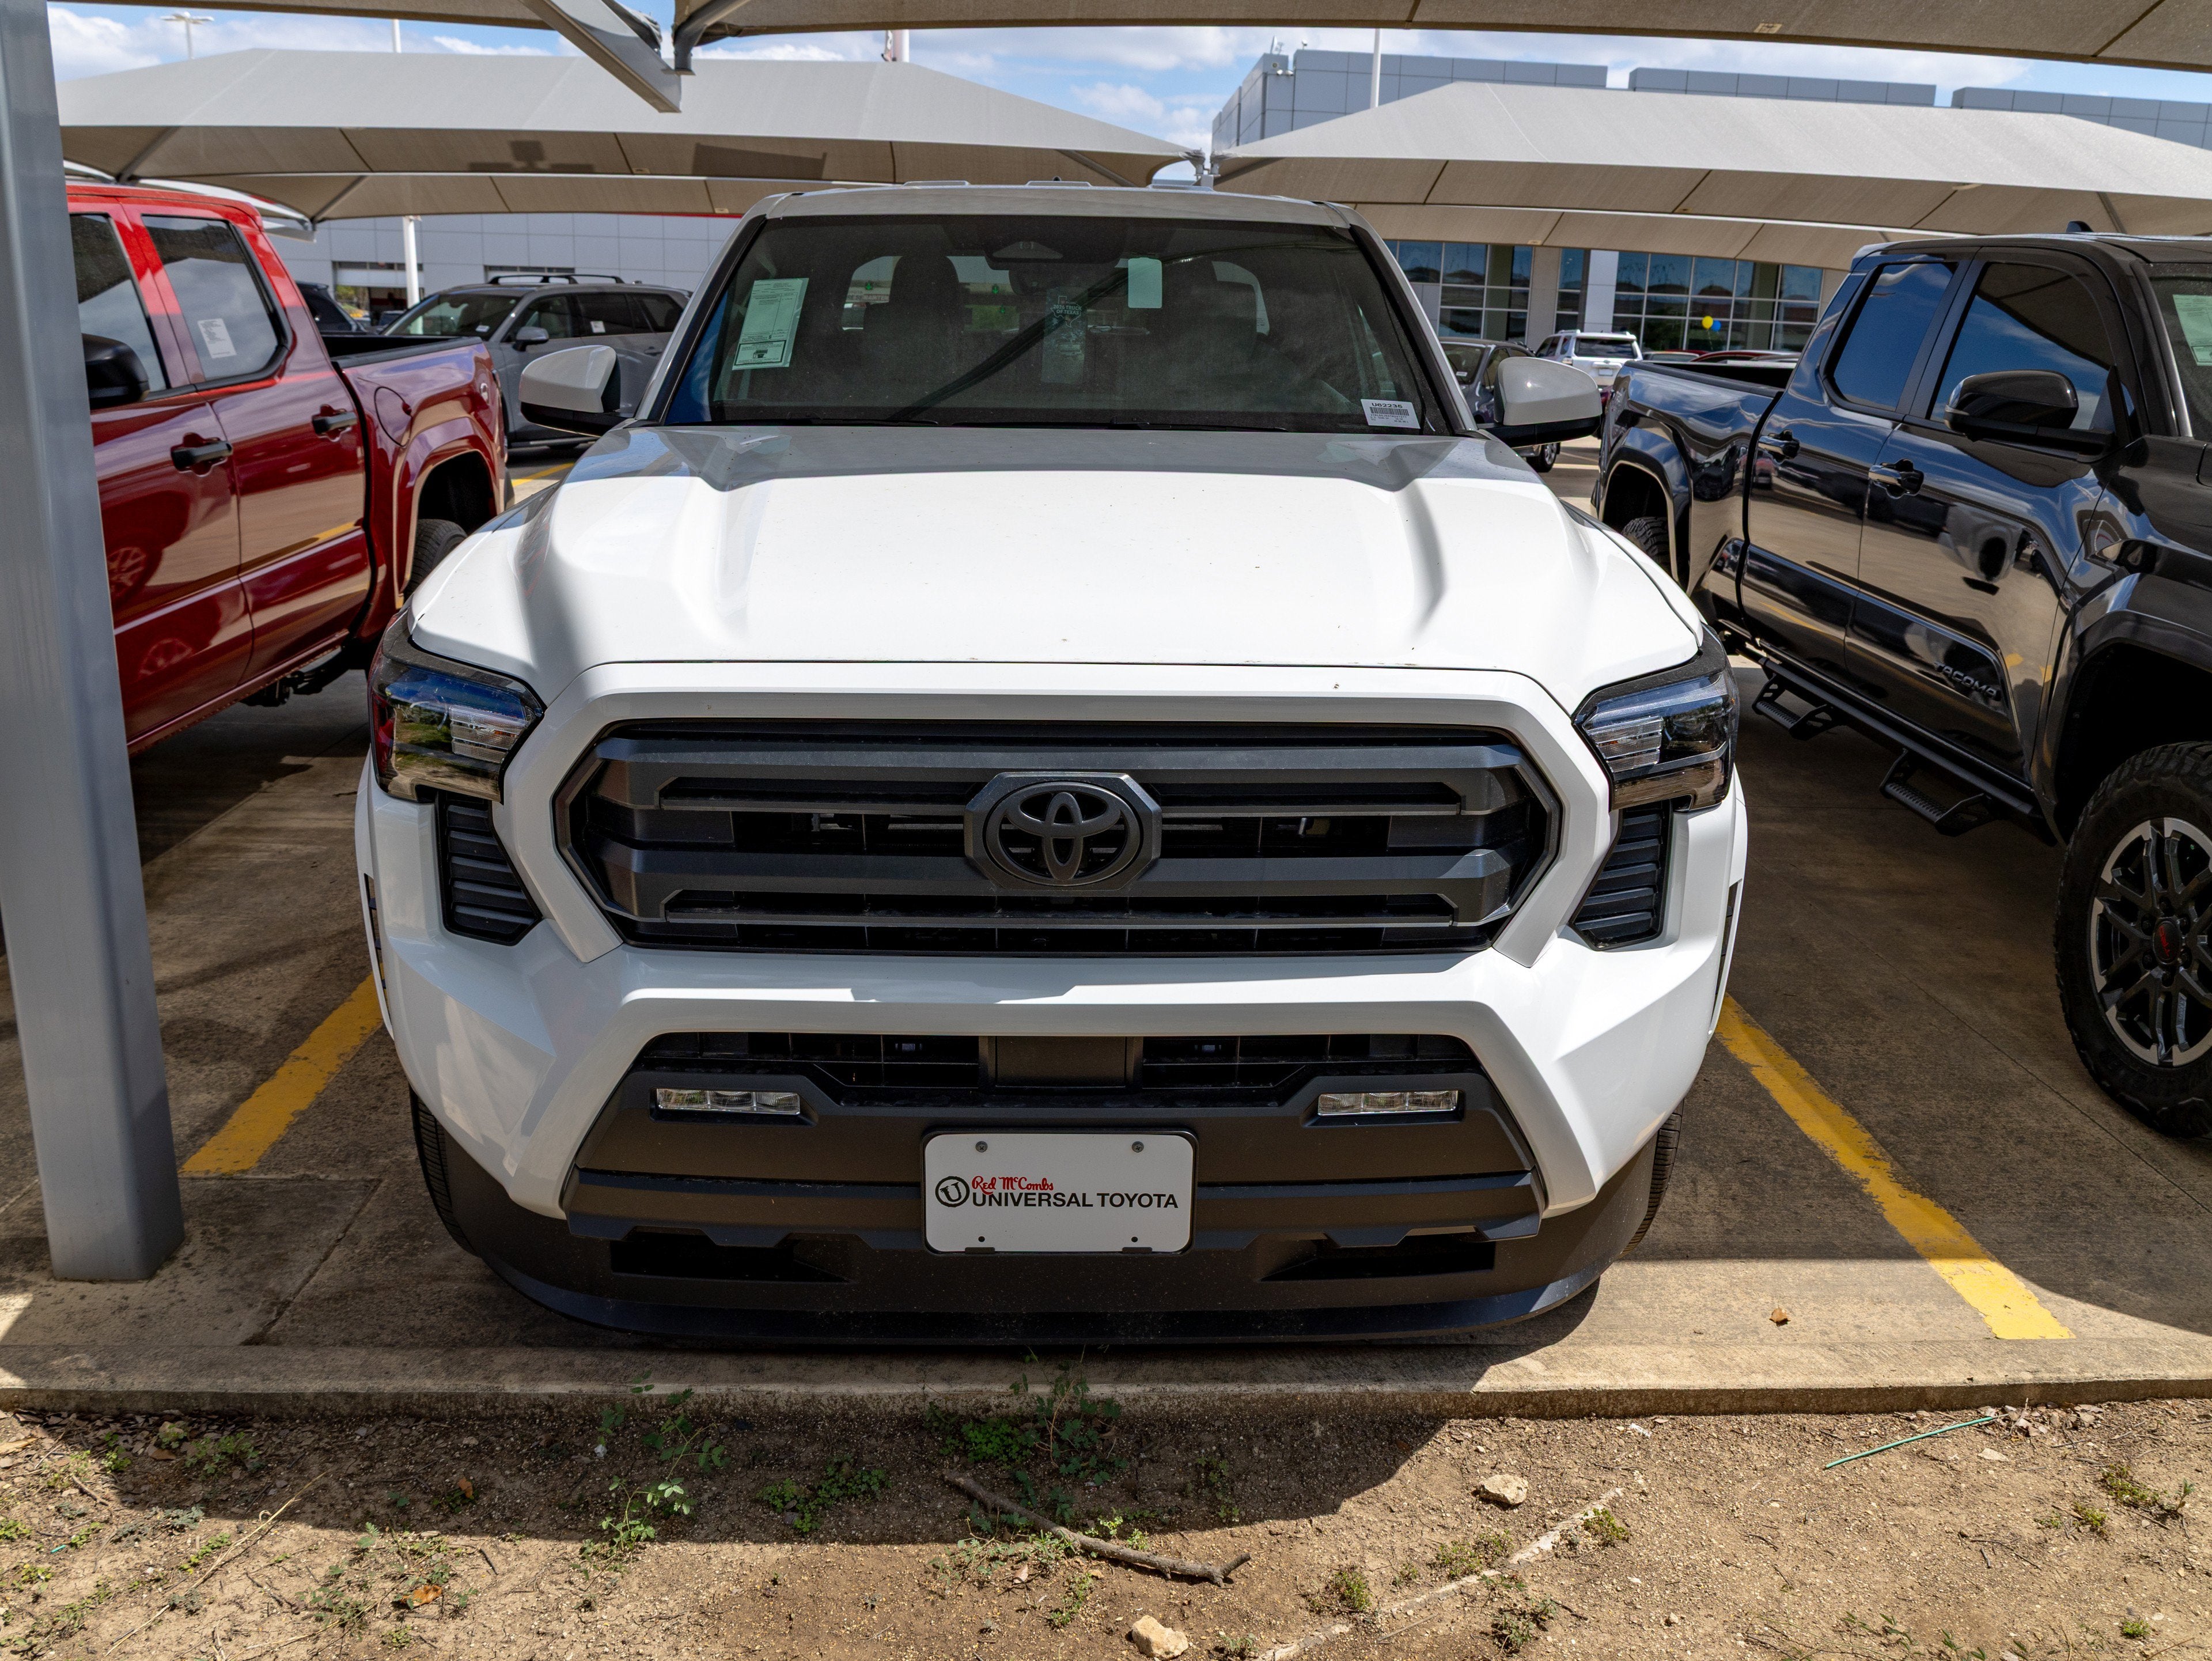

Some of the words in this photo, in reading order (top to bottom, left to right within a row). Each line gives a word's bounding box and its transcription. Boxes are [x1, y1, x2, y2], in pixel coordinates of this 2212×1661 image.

[1934, 661, 1997, 698] TACOMA
[971, 1176, 997, 1195] Red
[998, 1176, 1054, 1191] McCombs
[972, 1192, 1093, 1208] UNIVERSAL
[1096, 1193, 1179, 1209] TOYOTA
